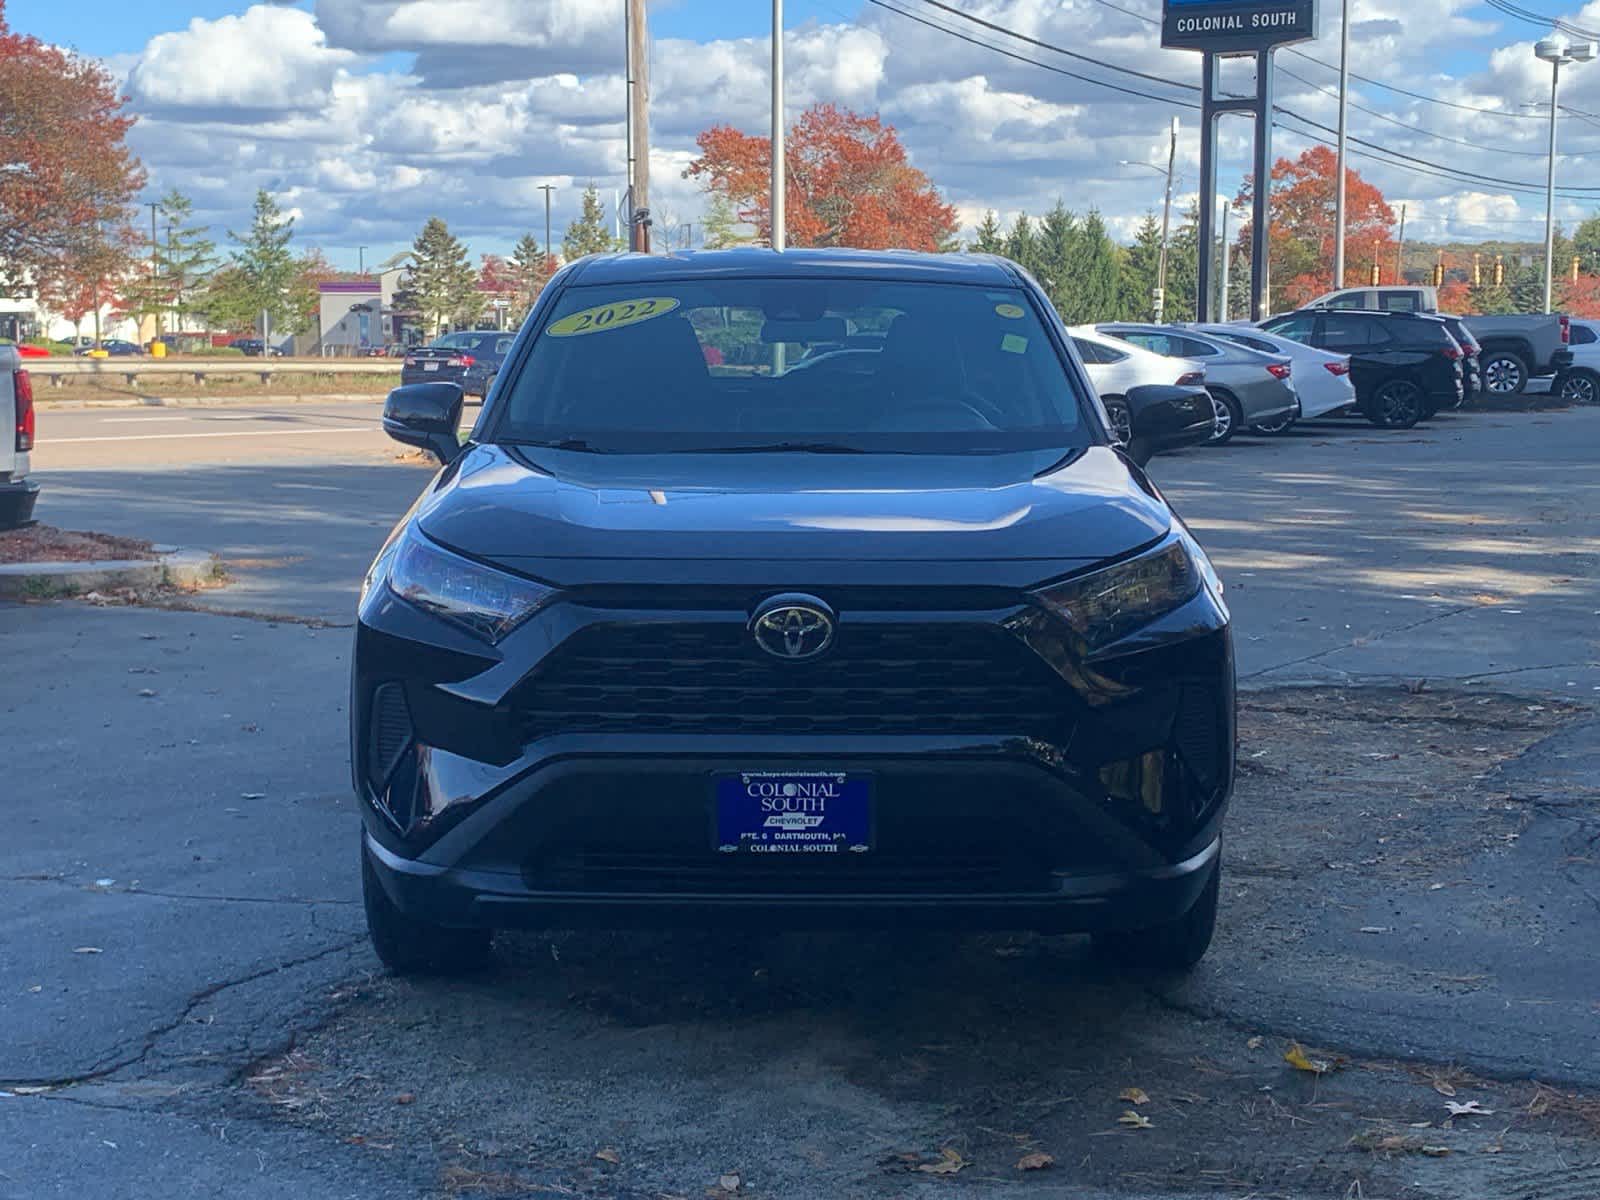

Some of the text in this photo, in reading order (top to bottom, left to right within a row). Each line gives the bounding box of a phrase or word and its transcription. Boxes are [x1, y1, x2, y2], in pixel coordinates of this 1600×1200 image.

[1177, 12, 1296, 32] COLONIAL SOUTH
[573, 300, 656, 332] 2022
[747, 783, 841, 797] COLONIAL
[761, 798, 825, 812] SOUTH
[769, 817, 818, 825] CHEVROLET
[774, 832, 832, 841] DARTMOUTH,
[750, 844, 838, 853] COLONIAL SOUTH
